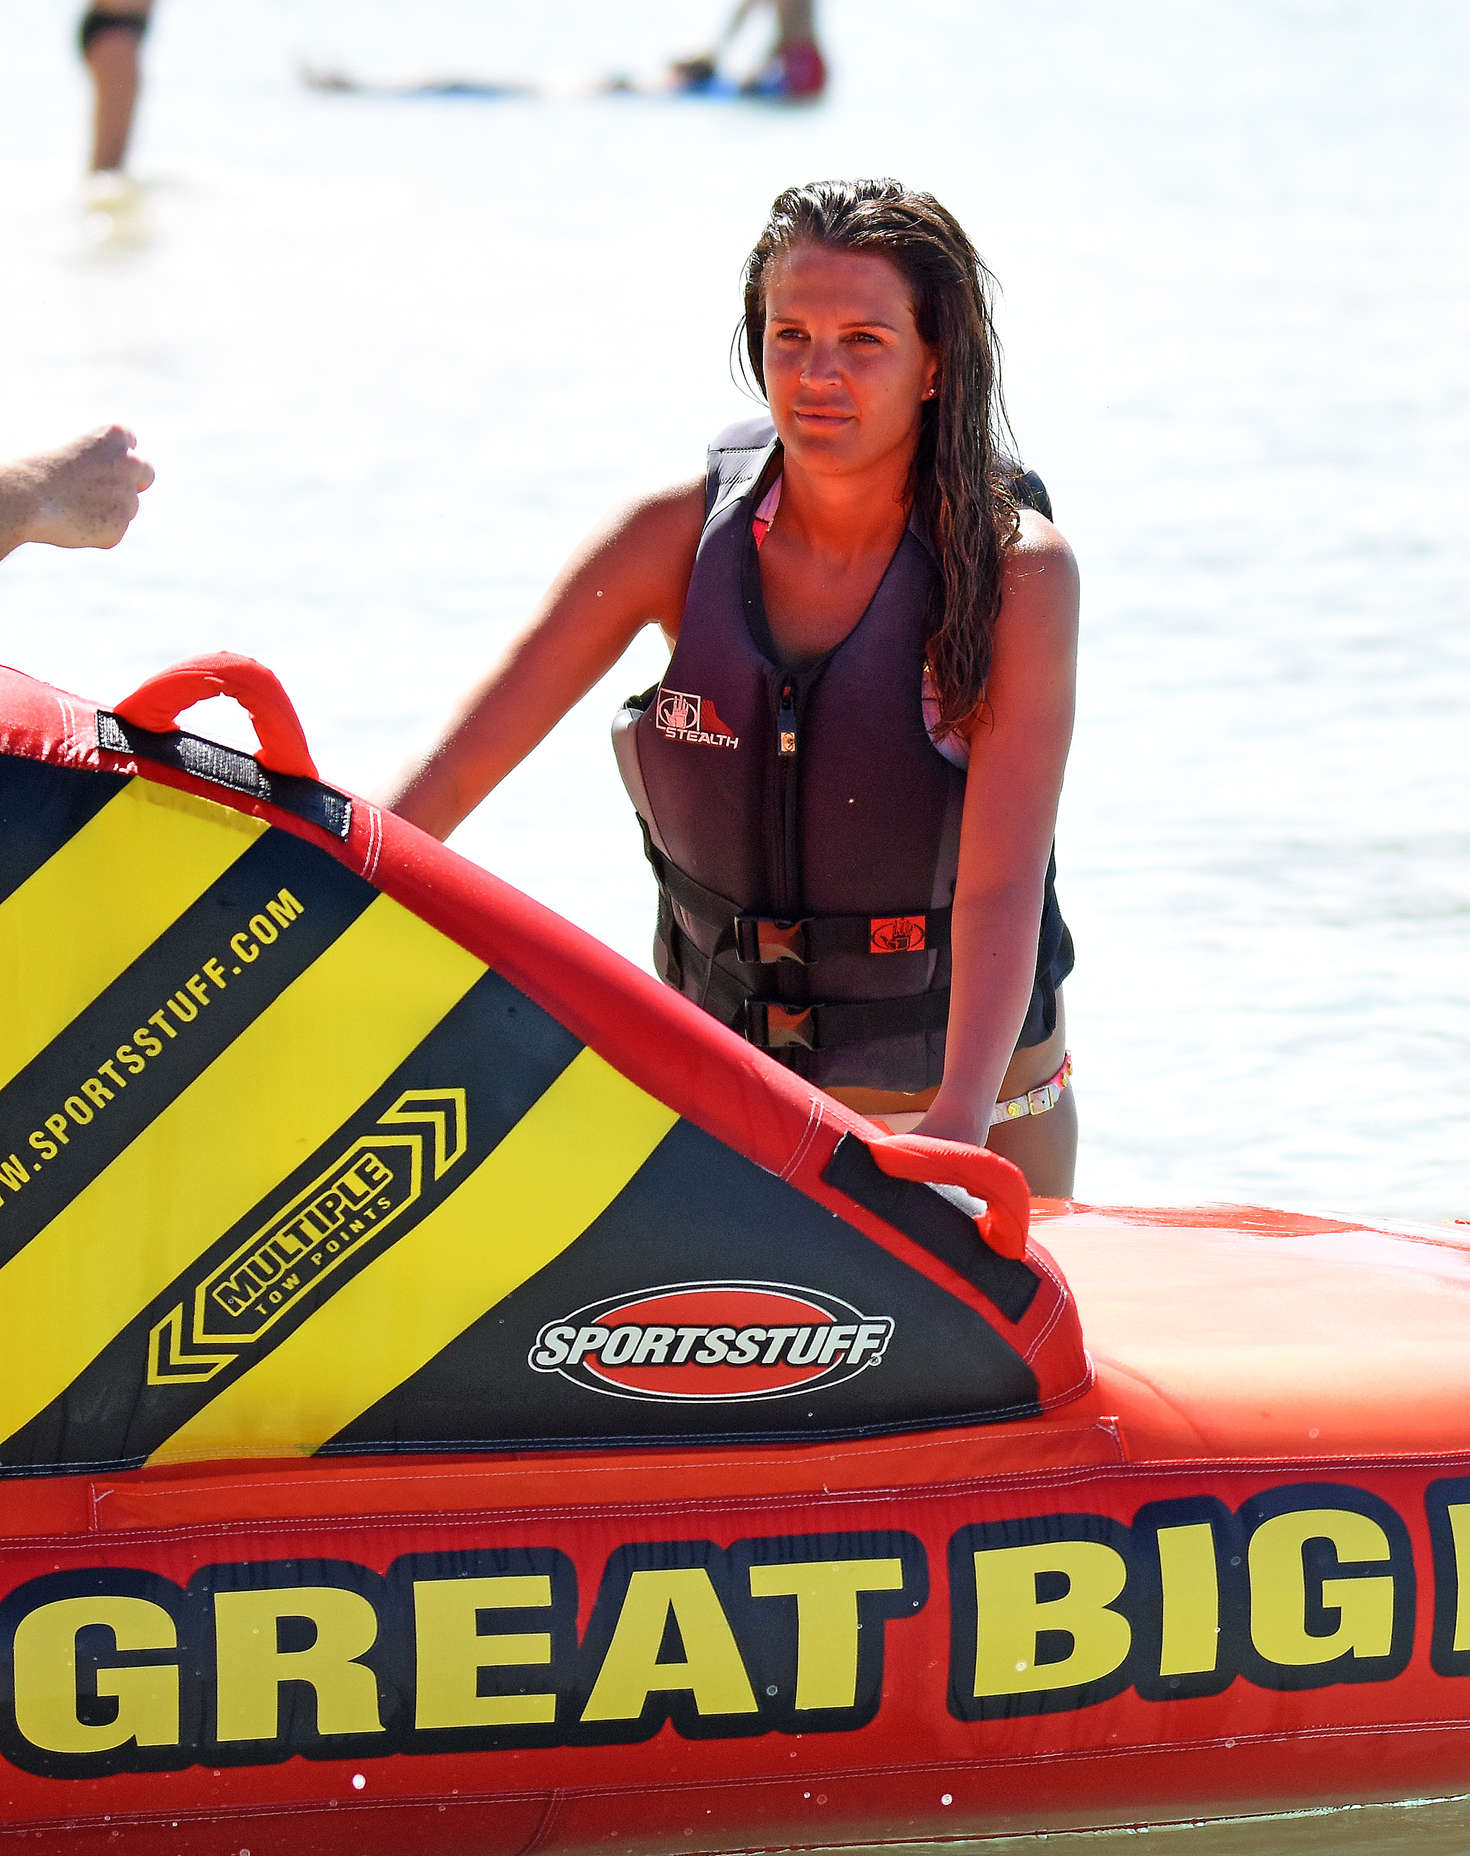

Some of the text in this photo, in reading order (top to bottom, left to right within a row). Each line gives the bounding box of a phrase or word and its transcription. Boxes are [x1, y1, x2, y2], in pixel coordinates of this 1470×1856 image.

[665, 727, 739, 750] STEALTH
[0, 887, 305, 1207] W.SPORTSSTUFF.COM
[212, 1152, 394, 1317] MULTIPLE
[254, 1196, 392, 1316] TOW POINTS
[535, 1324, 888, 1365] SPORTSSTUFF
[13, 1558, 904, 1754] GREAT
[973, 1508, 1394, 1697] BIG
